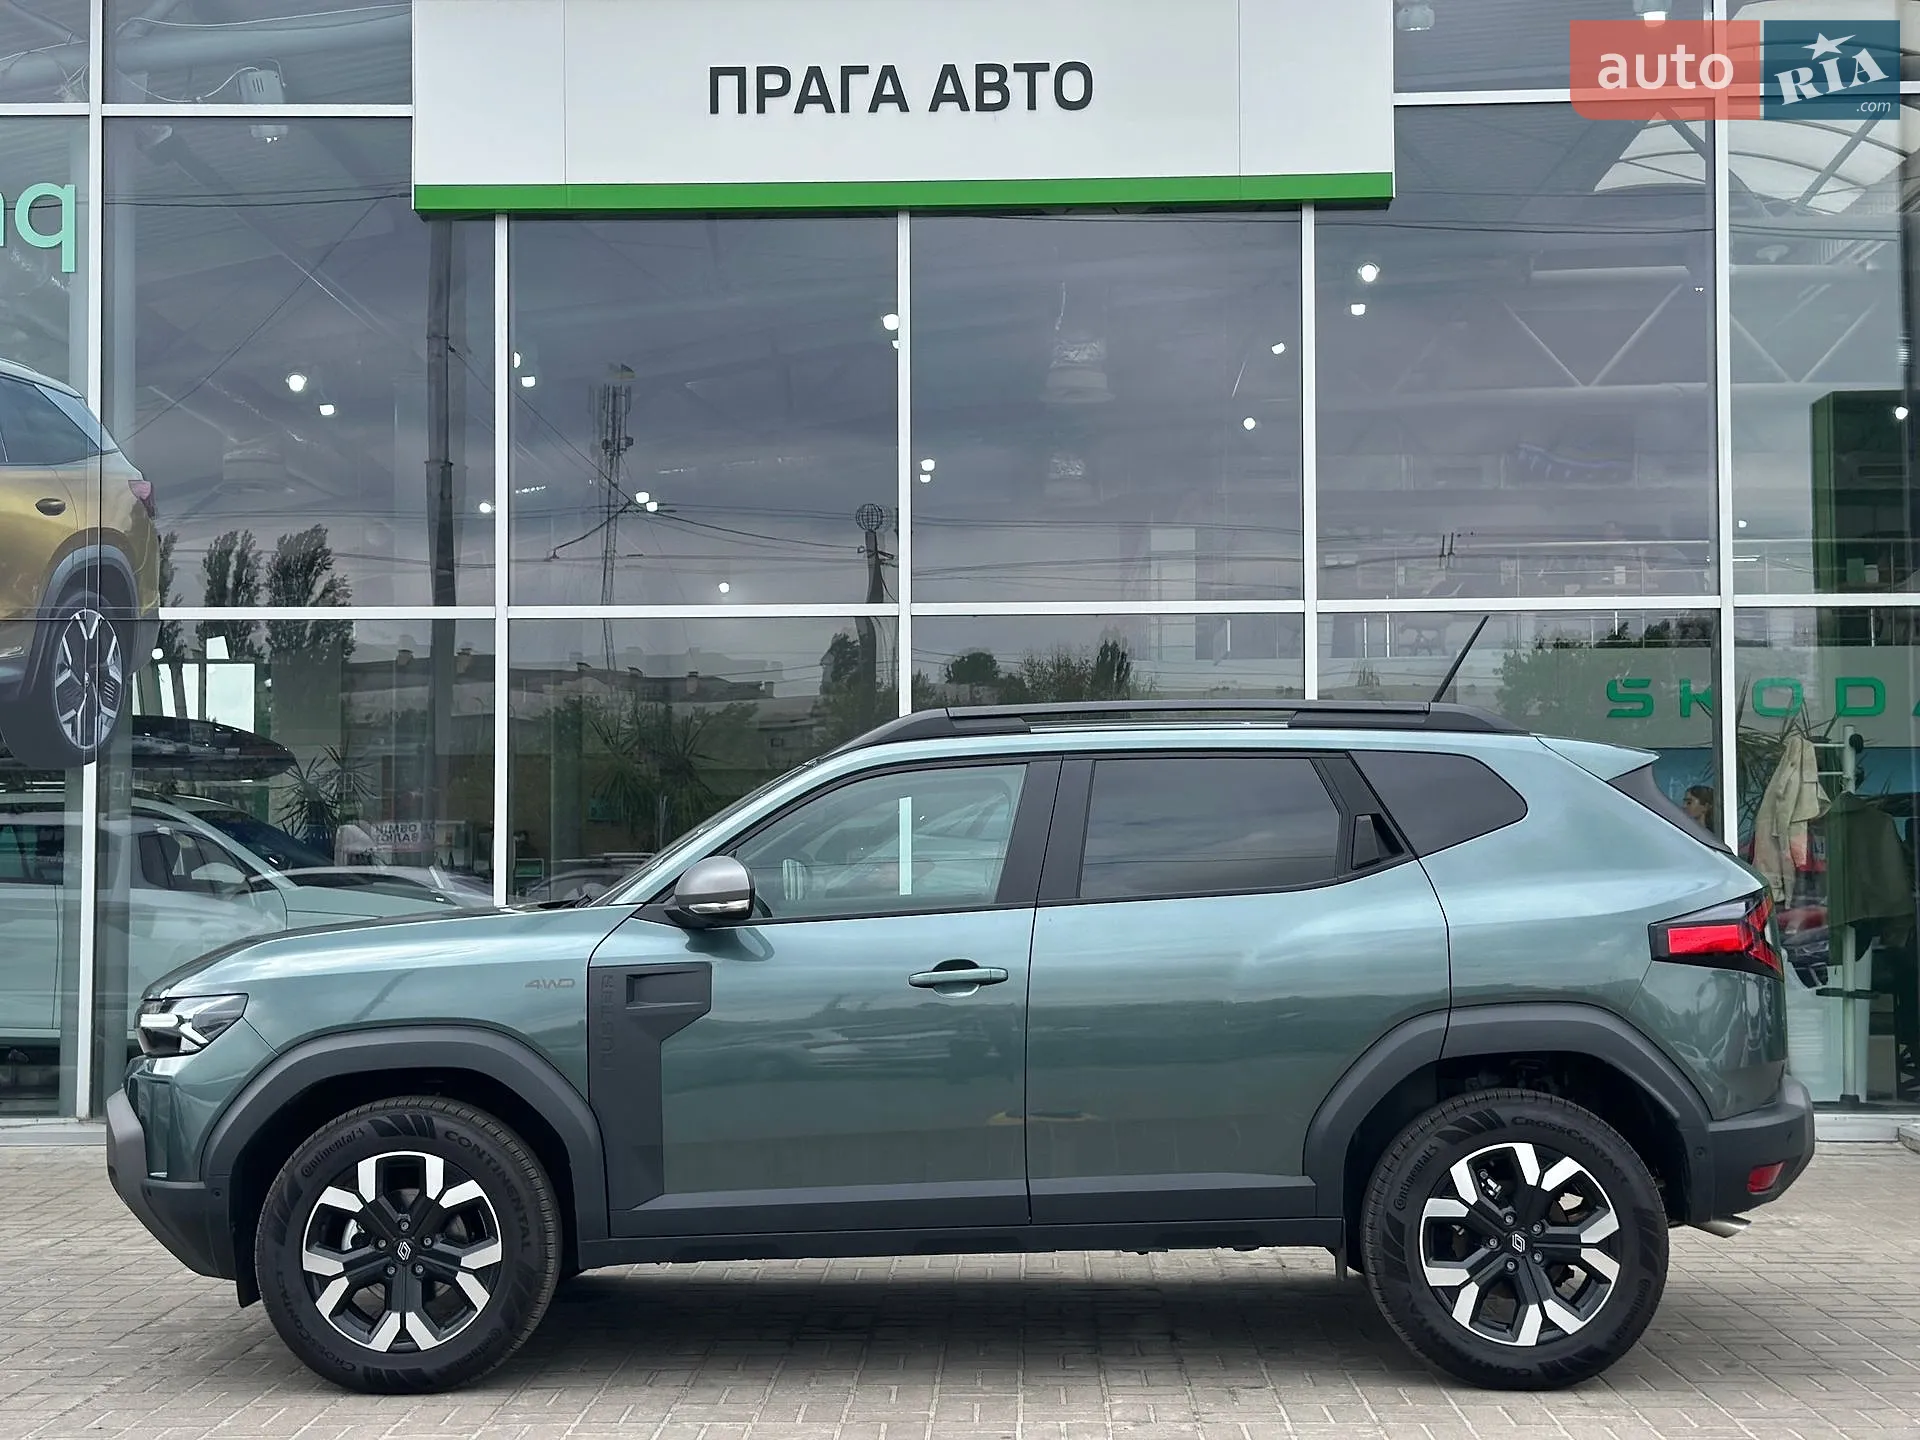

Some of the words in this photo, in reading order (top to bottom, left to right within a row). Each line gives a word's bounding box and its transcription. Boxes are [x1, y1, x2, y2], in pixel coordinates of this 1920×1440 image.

[709, 65, 910, 114] ПРАГА
[928, 61, 1094, 112] АВТО
[524, 978, 576, 990] 4WD
